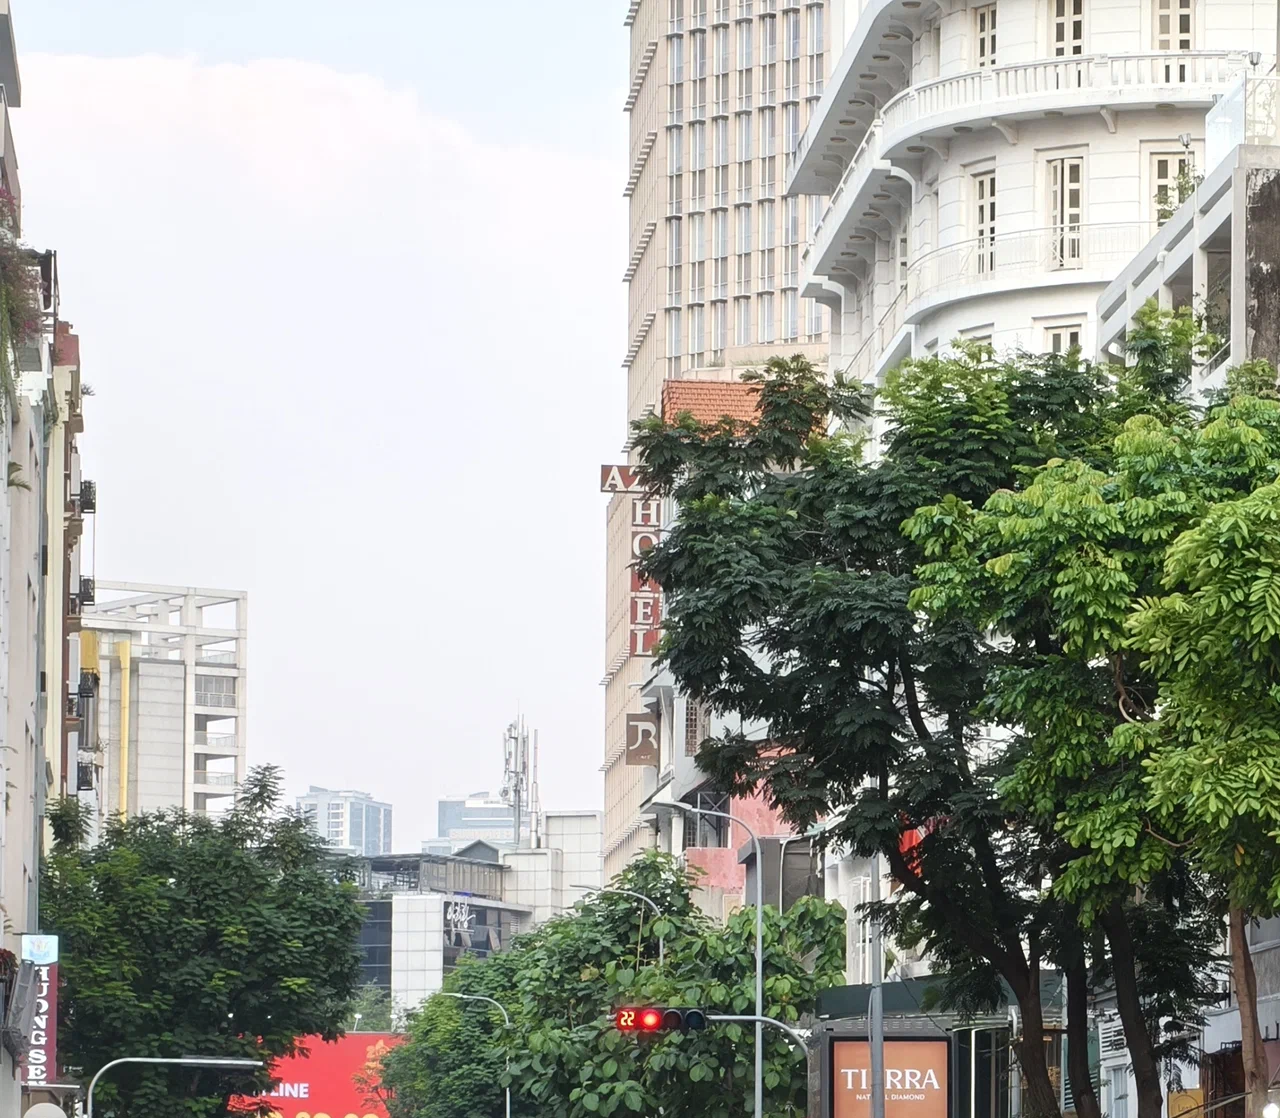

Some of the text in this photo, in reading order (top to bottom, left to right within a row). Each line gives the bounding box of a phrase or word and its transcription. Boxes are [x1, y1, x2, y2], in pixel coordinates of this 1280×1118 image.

[632, 500, 660, 656] HOEL
[620, 1011, 635, 1026] 22
[840, 1069, 940, 1090] TIRRA
